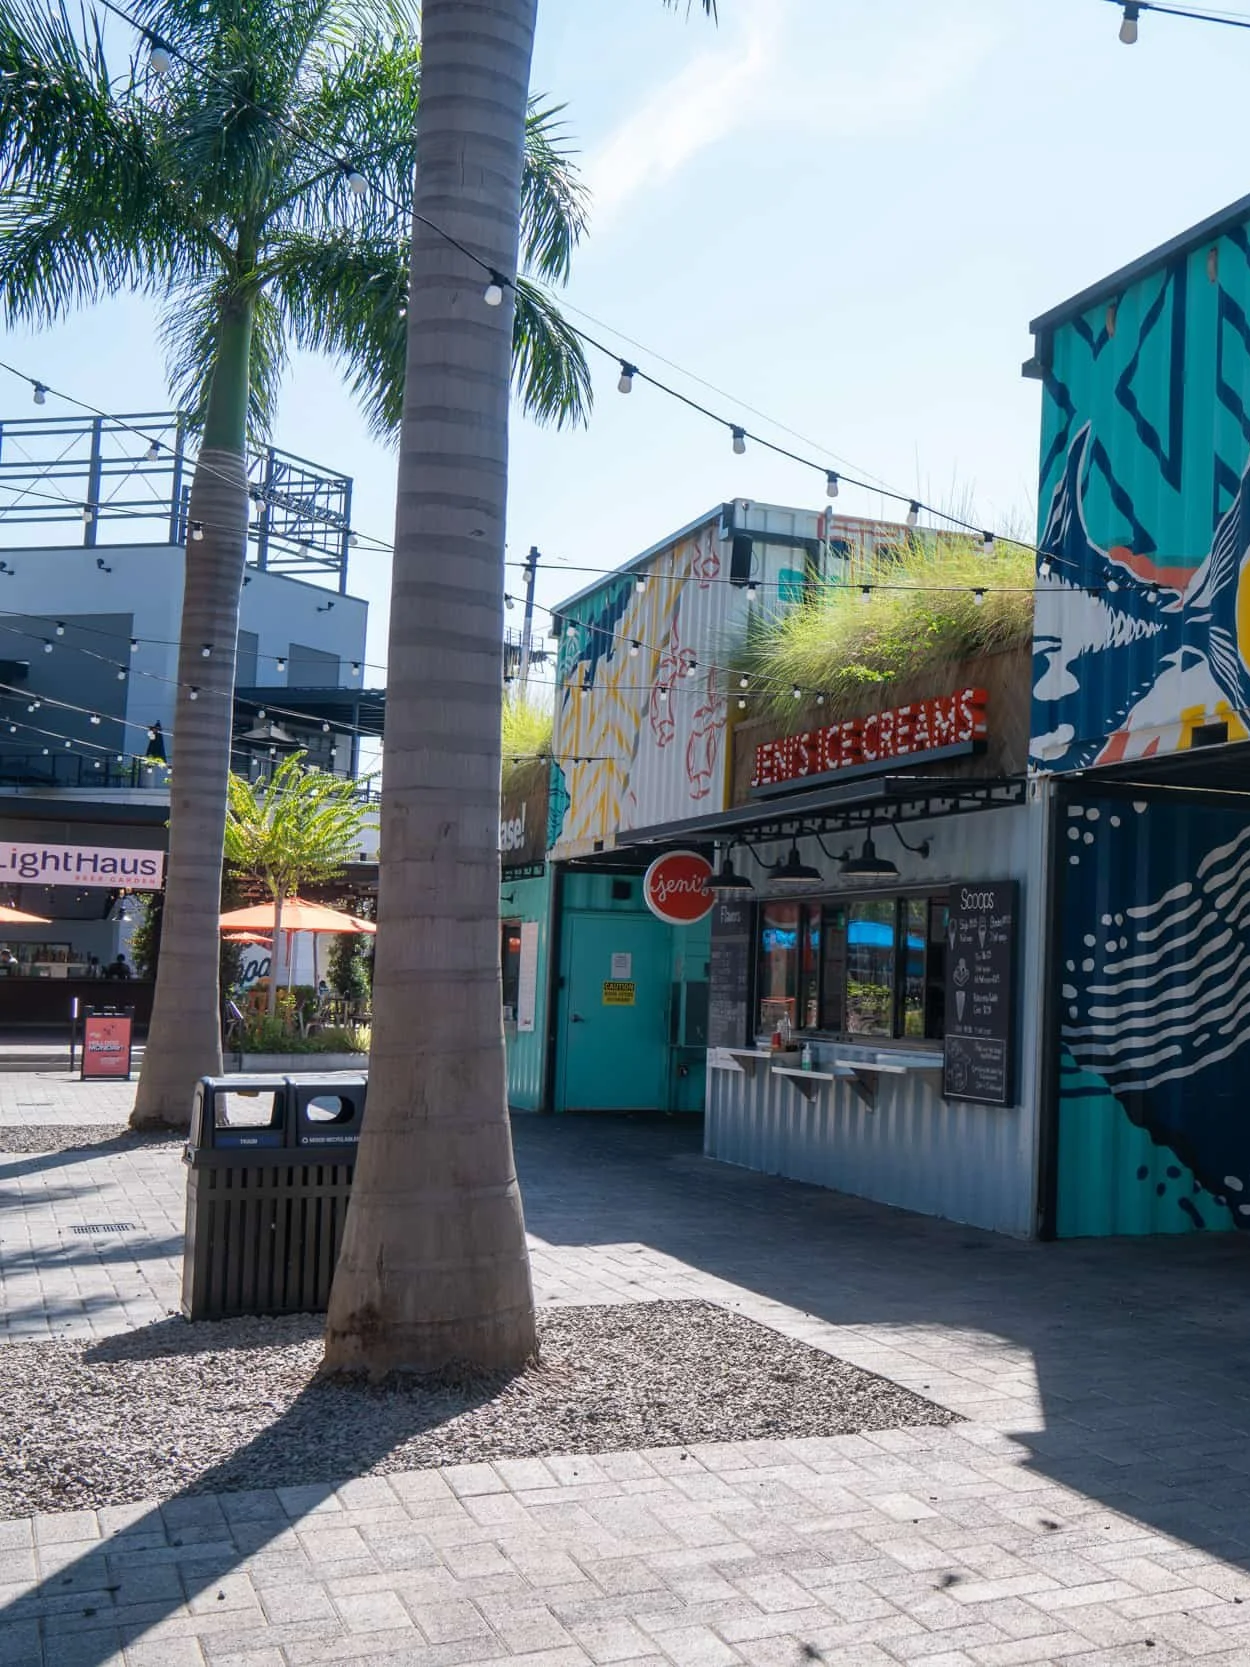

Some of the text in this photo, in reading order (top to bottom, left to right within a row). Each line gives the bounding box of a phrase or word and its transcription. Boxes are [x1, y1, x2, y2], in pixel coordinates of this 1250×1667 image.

[817, 720, 856, 773] ICE
[861, 689, 977, 760] CREAMS
[0, 847, 157, 878] ightHaus
[110, 876, 156, 885] GARDEN
